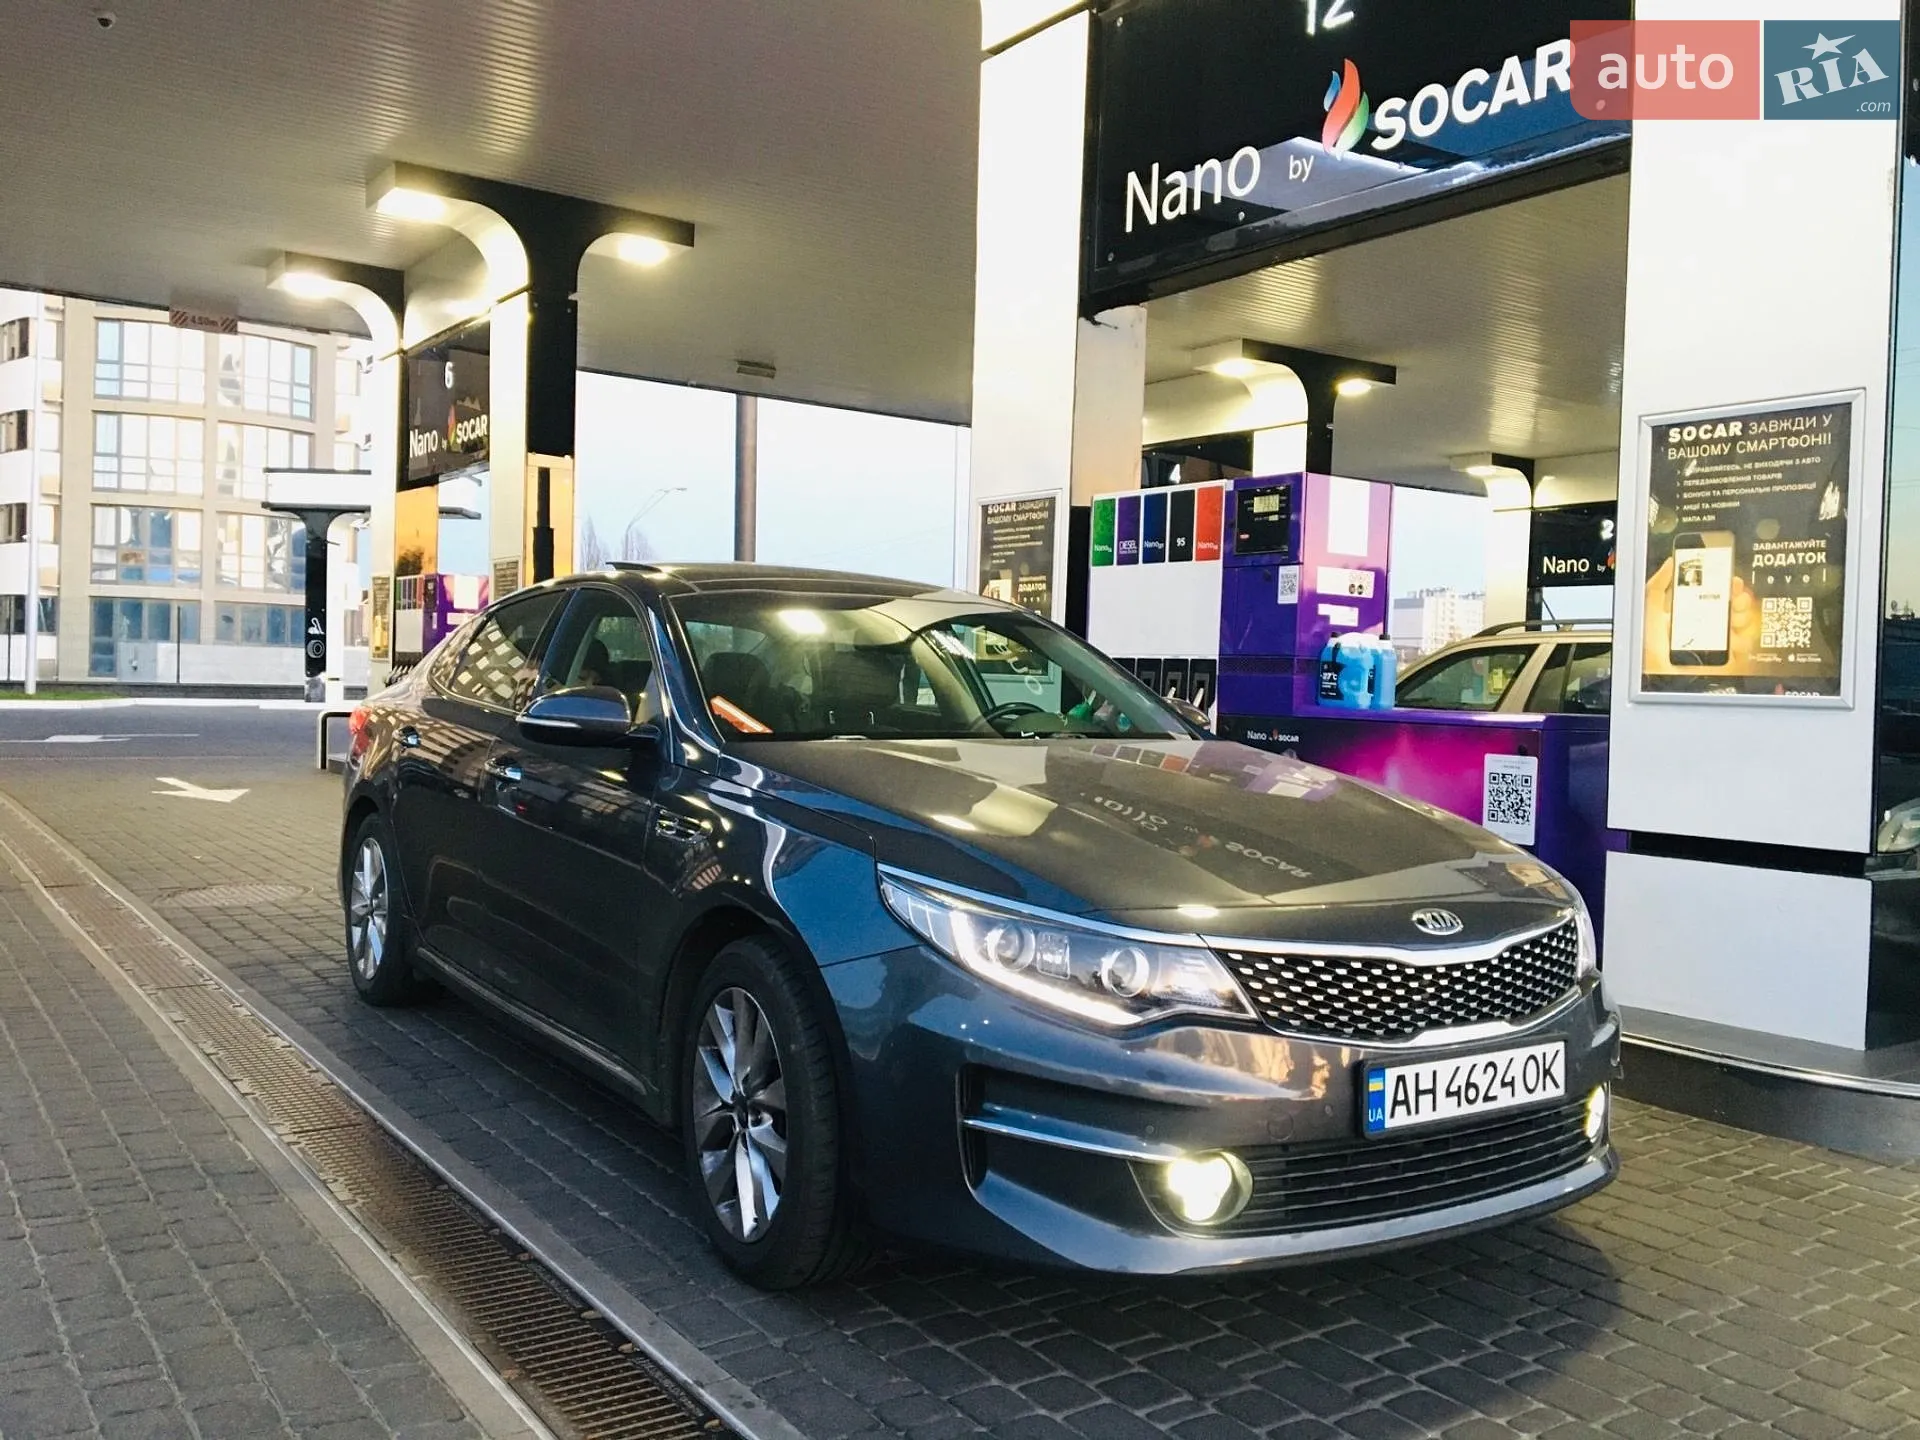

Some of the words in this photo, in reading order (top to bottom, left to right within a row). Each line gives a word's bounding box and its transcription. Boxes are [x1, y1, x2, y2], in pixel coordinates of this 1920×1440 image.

[1125, 146, 1261, 233] Nano
[1288, 154, 1315, 183] by
[1370, 38, 1576, 151] SOCAR
[444, 361, 454, 389] 6
[409, 428, 438, 458] Nano
[456, 414, 488, 444] SOCAR
[1668, 421, 1743, 443] SOCAR
[1748, 417, 1817, 435] ЗАВЖДИ
[1822, 414, 1833, 428] У
[1667, 443, 1731, 460] ВАШОМУ
[987, 502, 1017, 514] SOCAR
[1176, 537, 1186, 547] 95
[1752, 539, 1827, 551] ЗАВАНТАЖУЙТЕ
[1542, 555, 1590, 575] Nano
[1752, 551, 1827, 568] ДОДАТОК
[1389, 1069, 1437, 1119] AH
[1445, 1057, 1516, 1108] 4624
[1522, 1049, 1561, 1094] OK
[1368, 1109, 1384, 1122] UA
